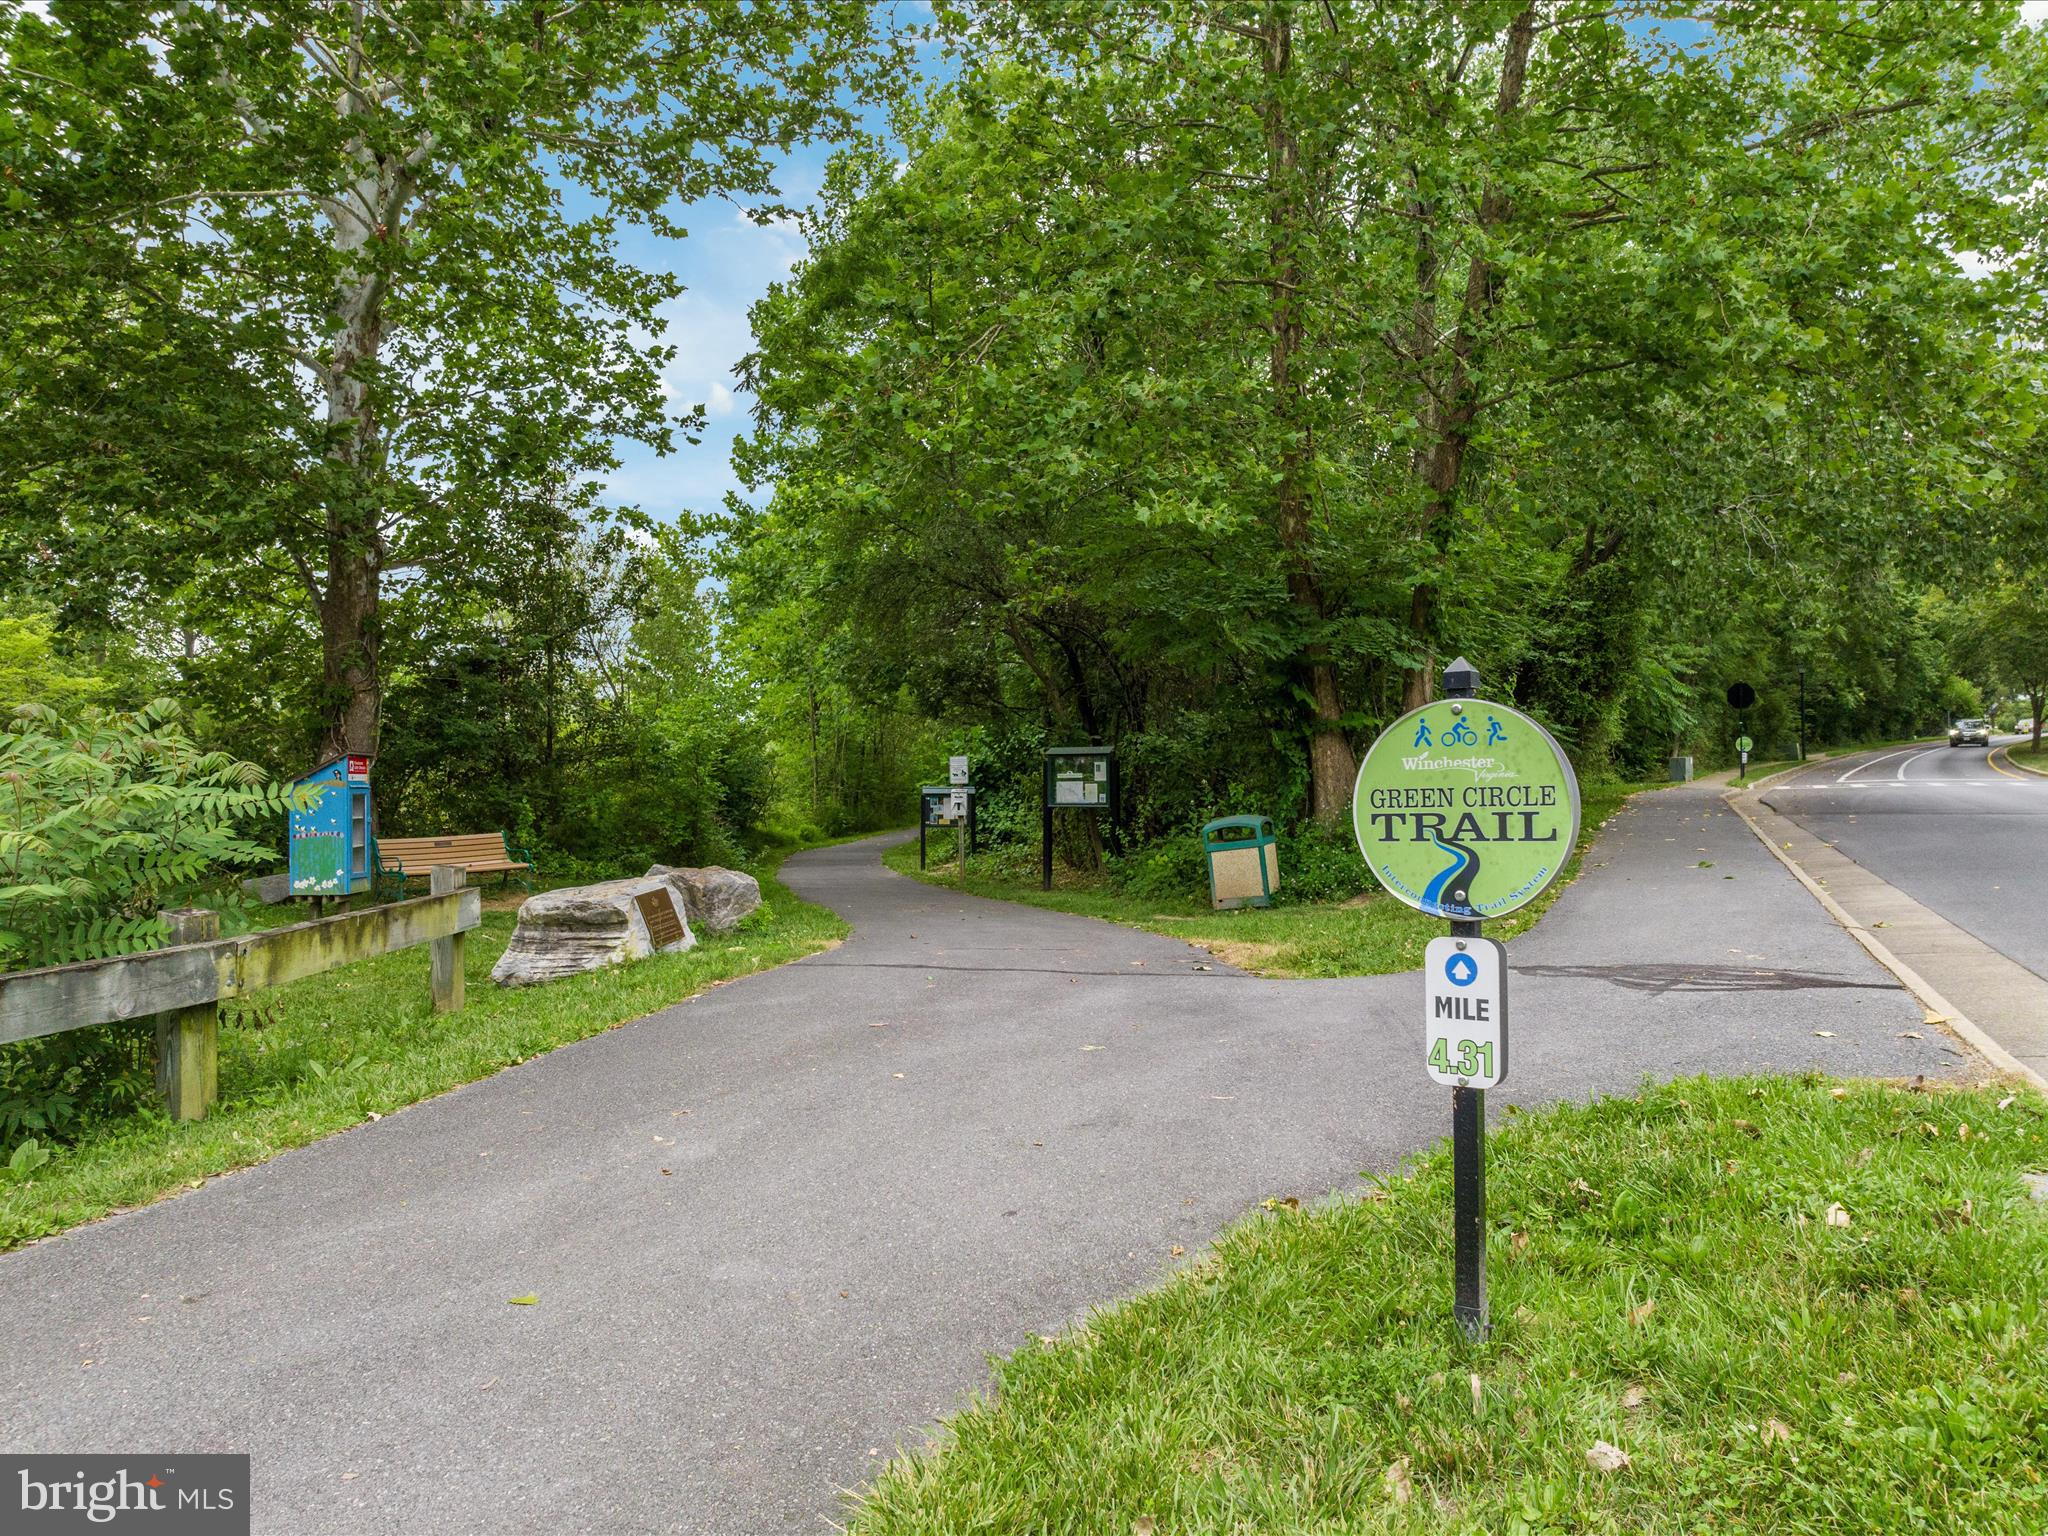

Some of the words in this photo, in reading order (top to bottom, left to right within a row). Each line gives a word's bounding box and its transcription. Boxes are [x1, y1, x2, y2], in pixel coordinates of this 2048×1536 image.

[1401, 753, 1495, 770] Winchester
[1370, 788, 1454, 809] GREEN
[1463, 786, 1556, 808] CIRCLE
[1371, 811, 1557, 842] TRAIL
[1477, 899, 1507, 913] Trail
[1509, 866, 1549, 901] System
[1435, 996, 1489, 1022] MILE
[1428, 1038, 1494, 1078] 4.31
